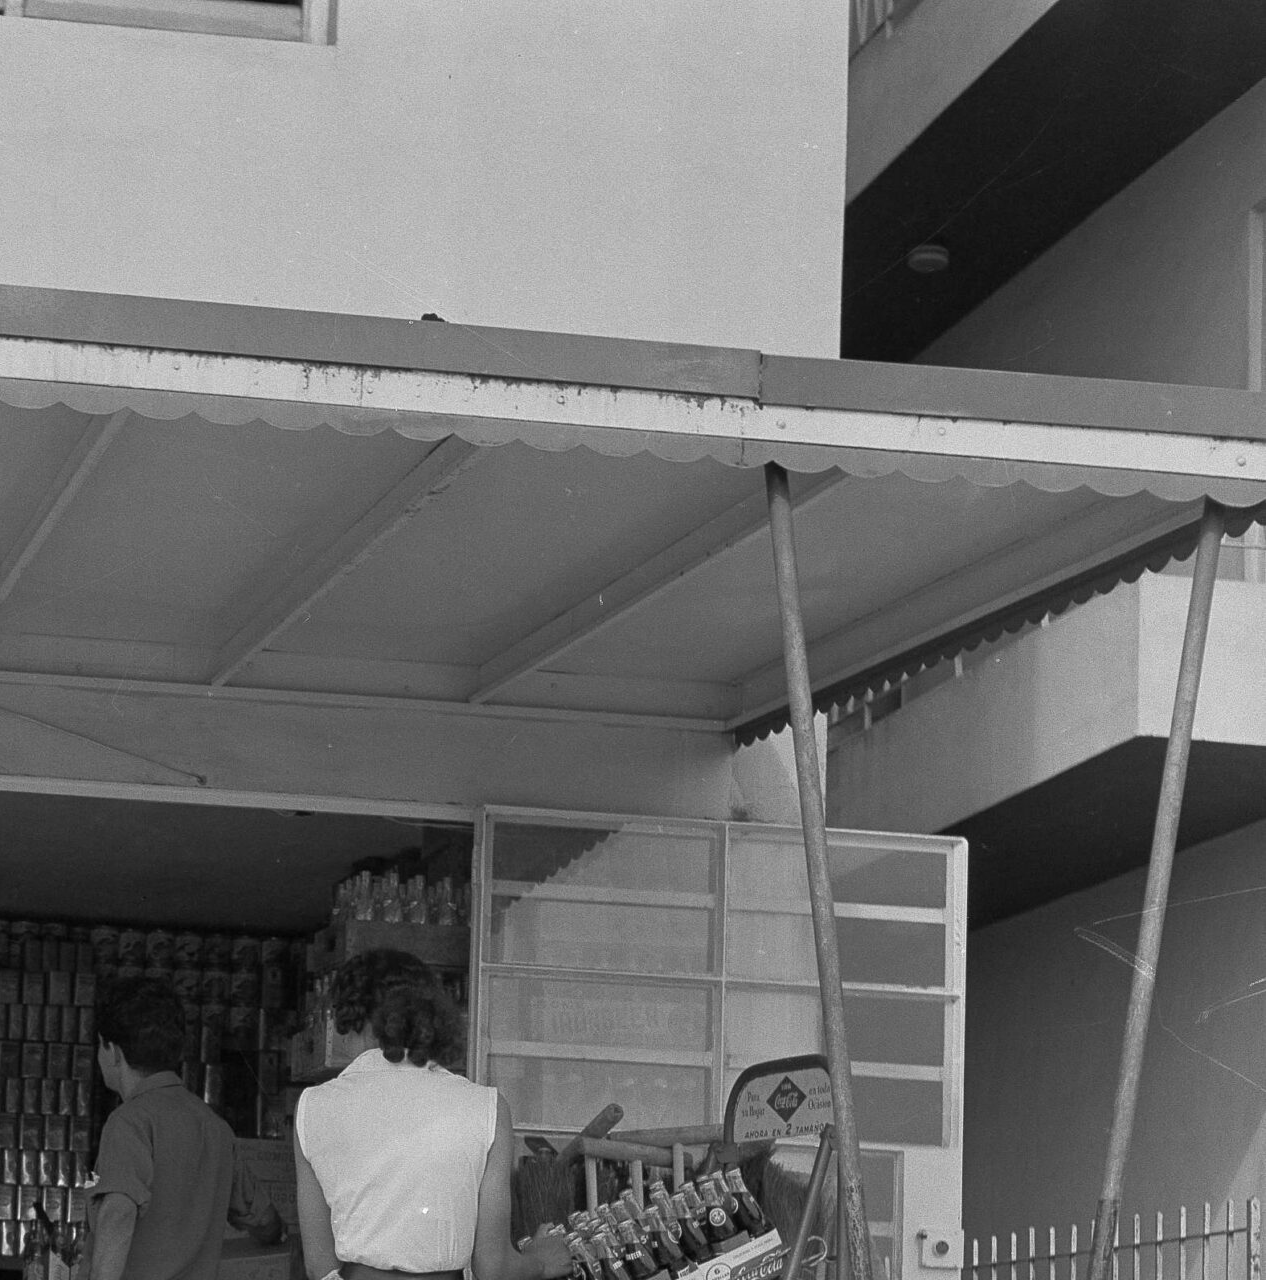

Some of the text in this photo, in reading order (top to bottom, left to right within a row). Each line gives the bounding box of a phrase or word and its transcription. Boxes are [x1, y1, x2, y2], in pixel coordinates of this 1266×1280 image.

[744, 1121, 825, 1139] AHORA EN 2 TAMAÑO
[714, 1267, 721, 1275] 6
